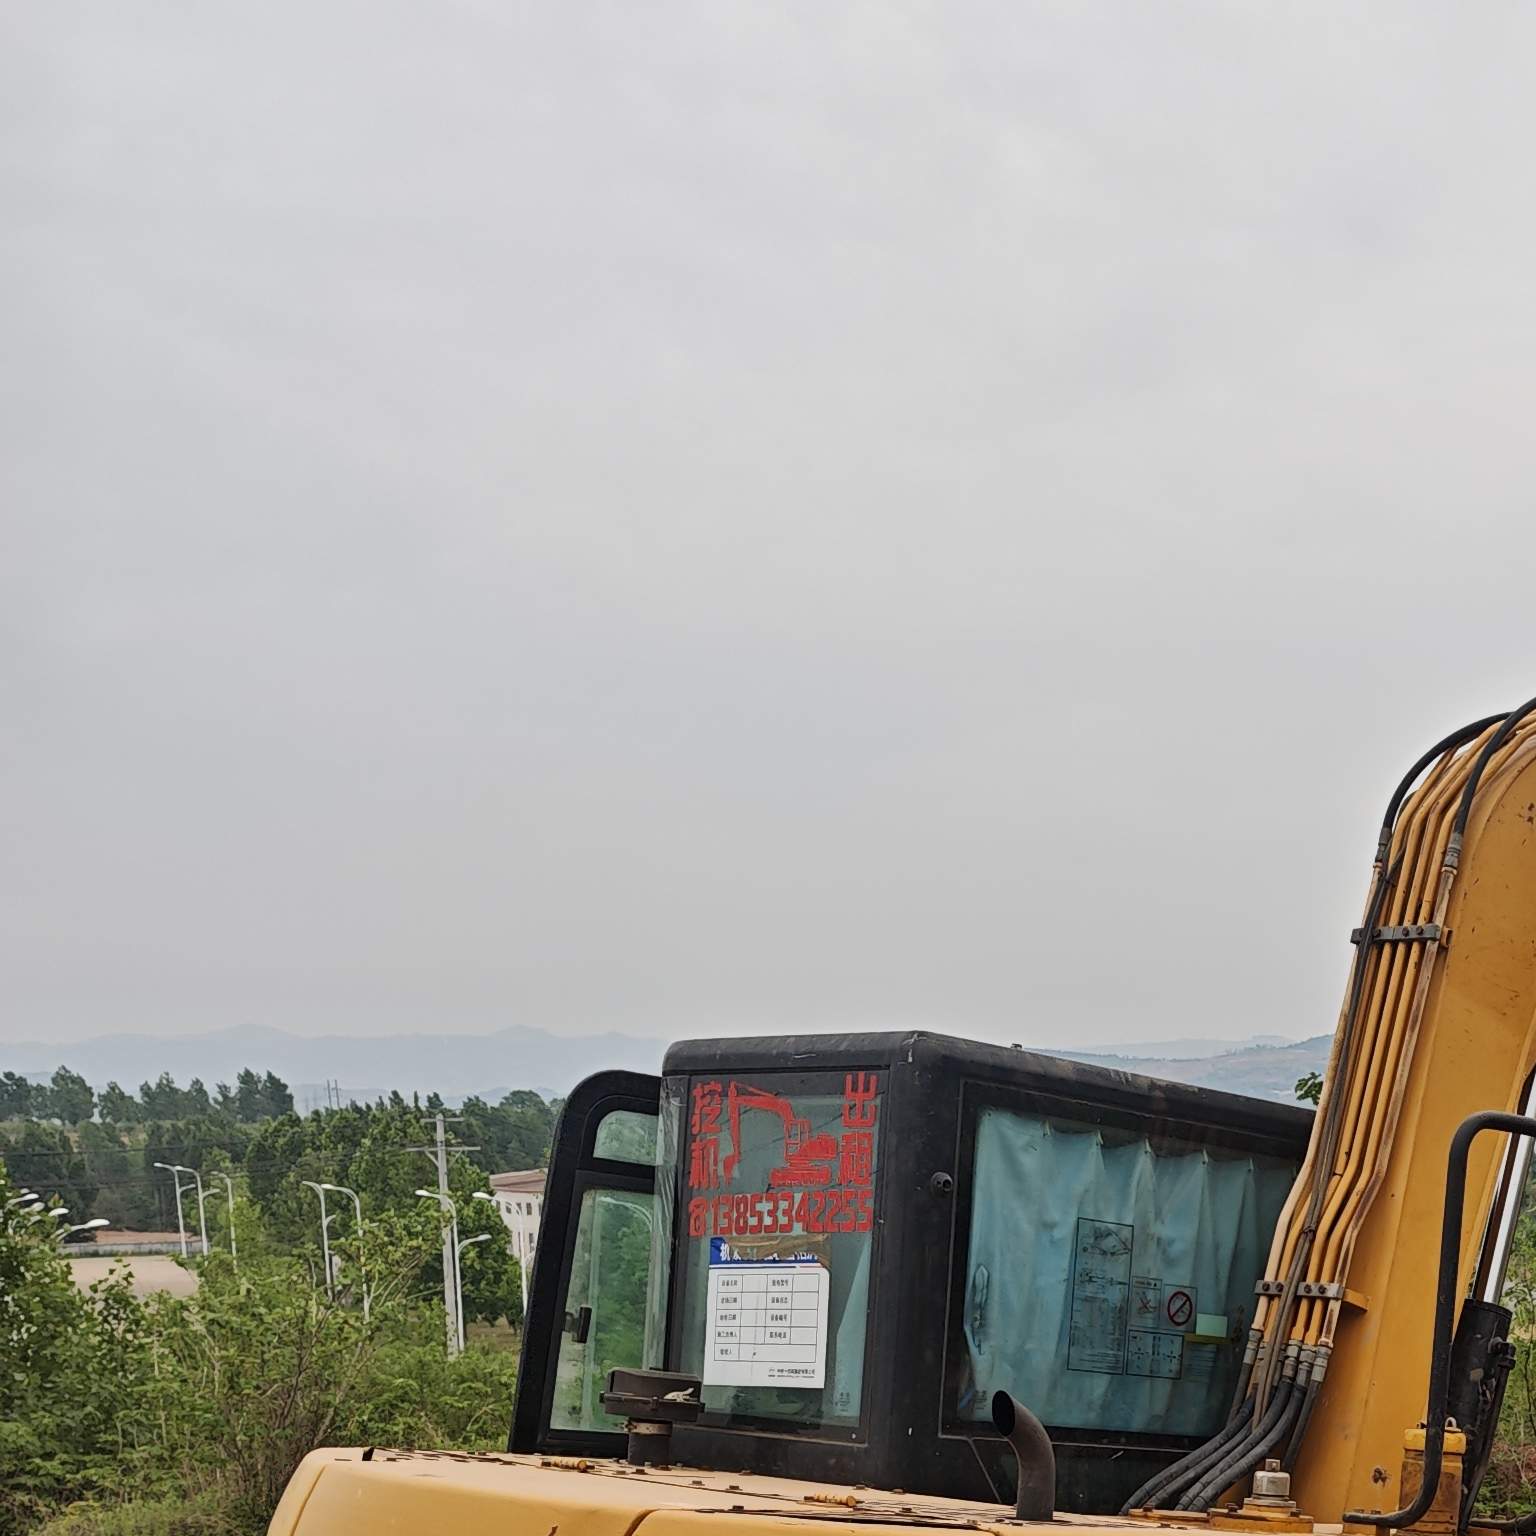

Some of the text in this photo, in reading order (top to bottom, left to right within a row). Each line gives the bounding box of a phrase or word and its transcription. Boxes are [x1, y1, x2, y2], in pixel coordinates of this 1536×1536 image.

[689, 1080, 723, 1190] 挖机
[837, 1071, 878, 1186] 出租
[711, 1189, 875, 1236] 13853342255
